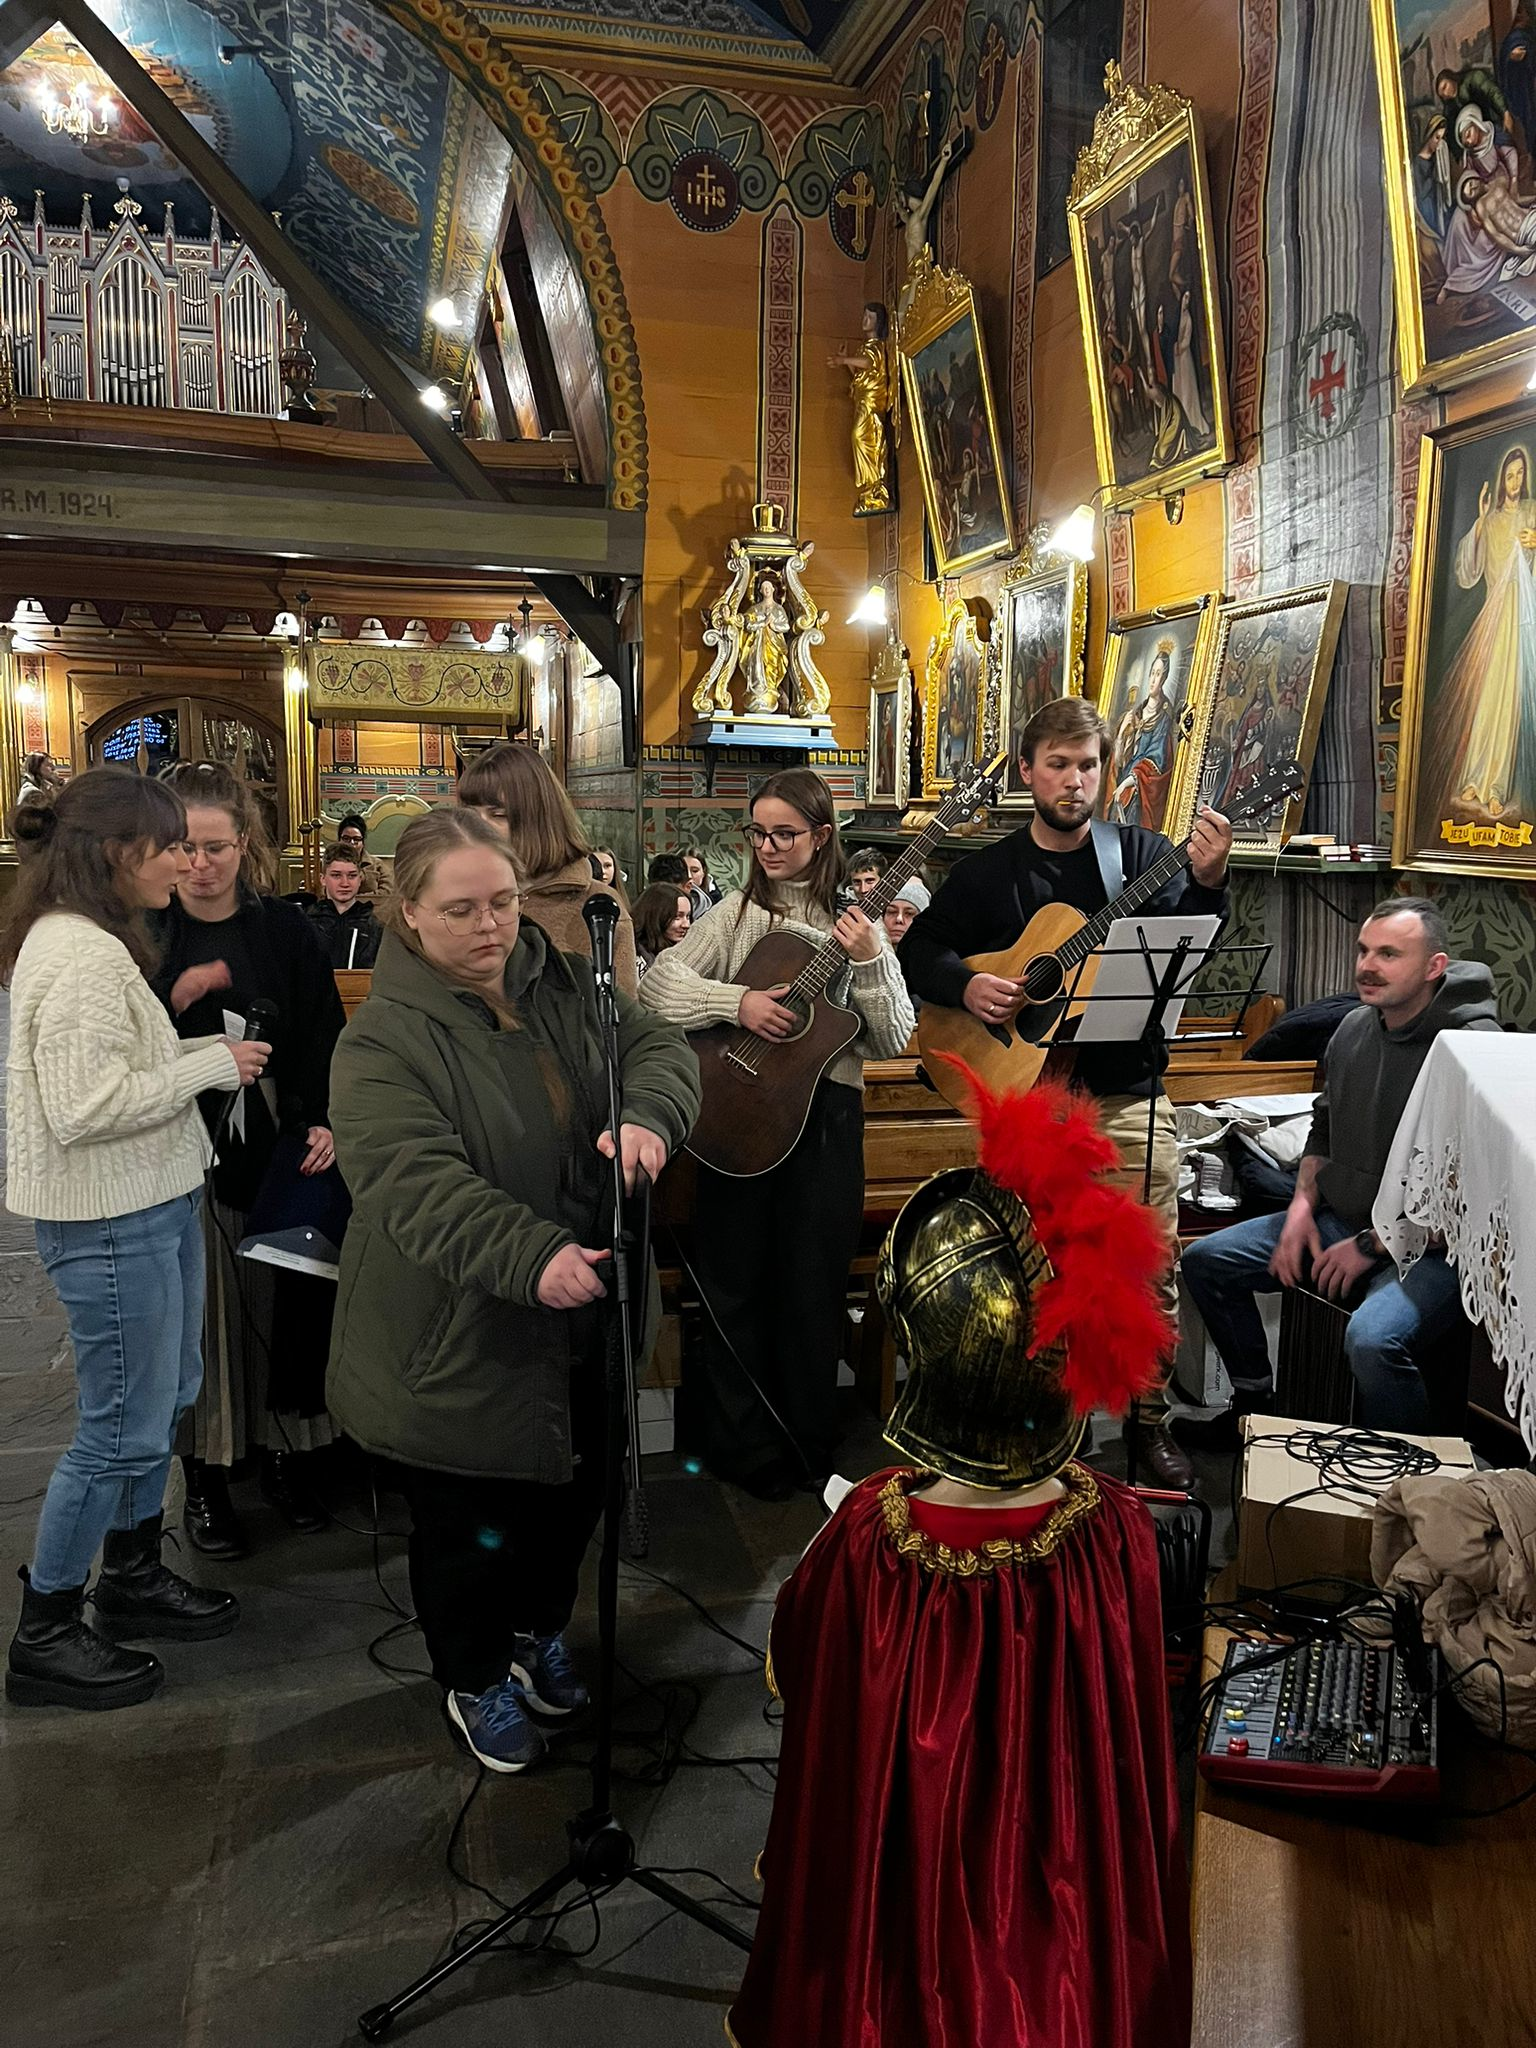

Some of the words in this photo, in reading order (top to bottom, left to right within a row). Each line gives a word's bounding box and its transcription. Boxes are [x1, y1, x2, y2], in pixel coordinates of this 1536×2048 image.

[687, 180, 726, 210] IHS
[1495, 287, 1528, 314] INRI
[1472, 831, 1496, 843] UFAM
[1499, 828, 1521, 844] TOBIE
